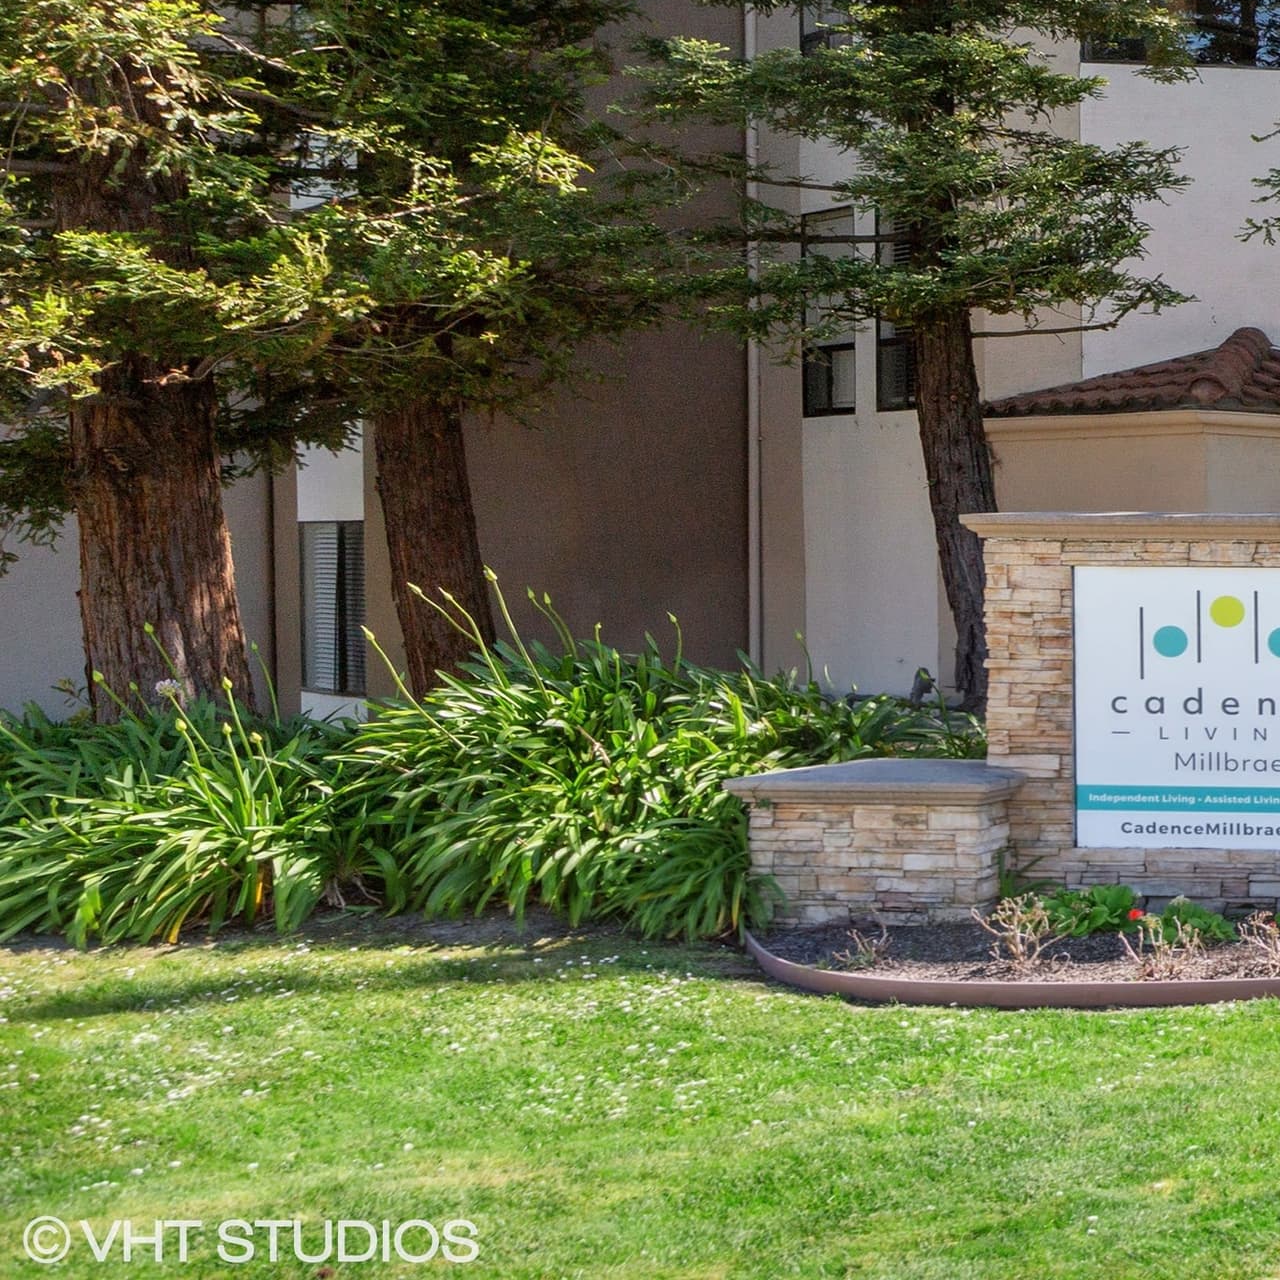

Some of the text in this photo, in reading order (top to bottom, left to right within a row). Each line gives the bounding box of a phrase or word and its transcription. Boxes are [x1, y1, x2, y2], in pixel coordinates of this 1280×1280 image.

[1088, 793, 1160, 804] Independent
[1162, 794, 1196, 805] Living
[1204, 795, 1251, 804] Assisted
